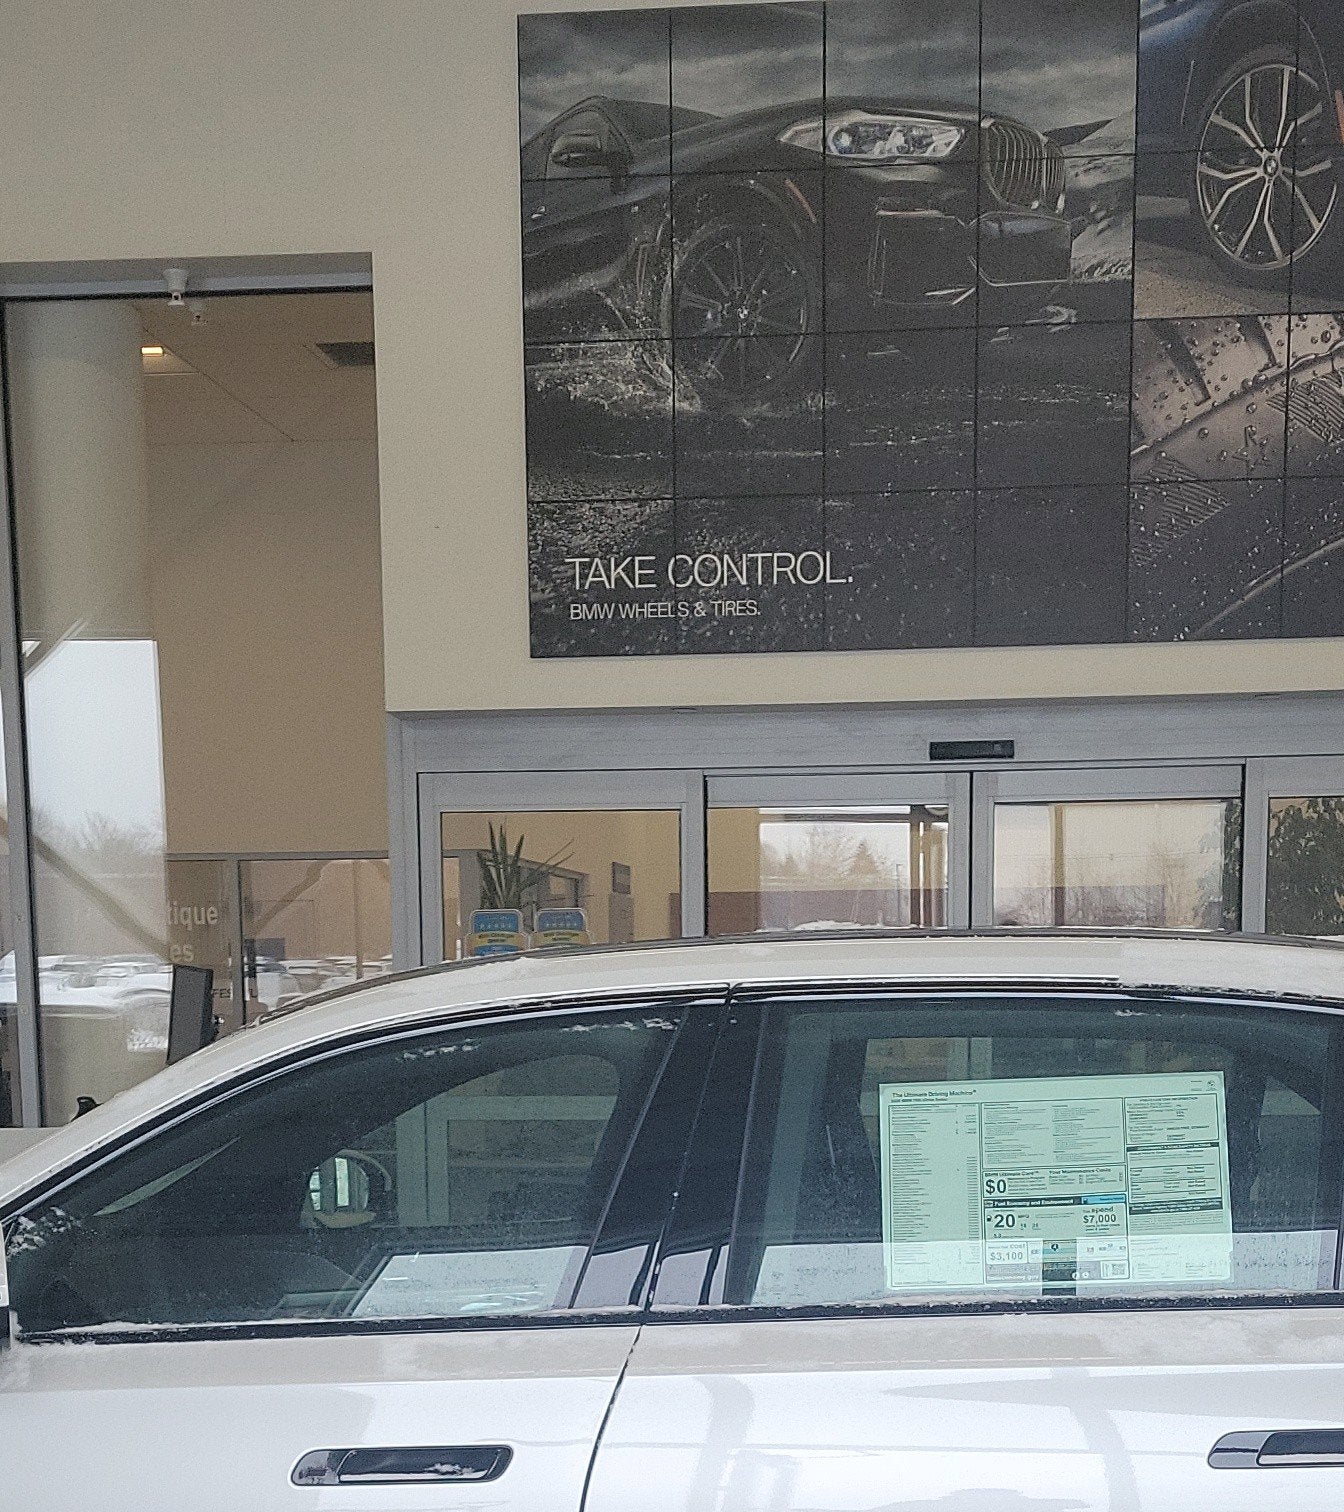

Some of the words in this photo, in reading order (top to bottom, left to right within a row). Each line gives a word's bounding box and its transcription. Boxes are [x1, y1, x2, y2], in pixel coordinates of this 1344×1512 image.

[564, 555, 656, 590] TAKE
[667, 551, 854, 589] CONTROL.
[569, 602, 615, 620] BMW
[618, 601, 690, 619] WHEELS
[693, 600, 707, 617] &
[711, 600, 761, 617] TIRES.
[985, 1179, 1007, 1195] $0
[994, 1213, 1016, 1228] 20
[1083, 1213, 1117, 1225] $7,000
[989, 1251, 1024, 1261] $3,100
